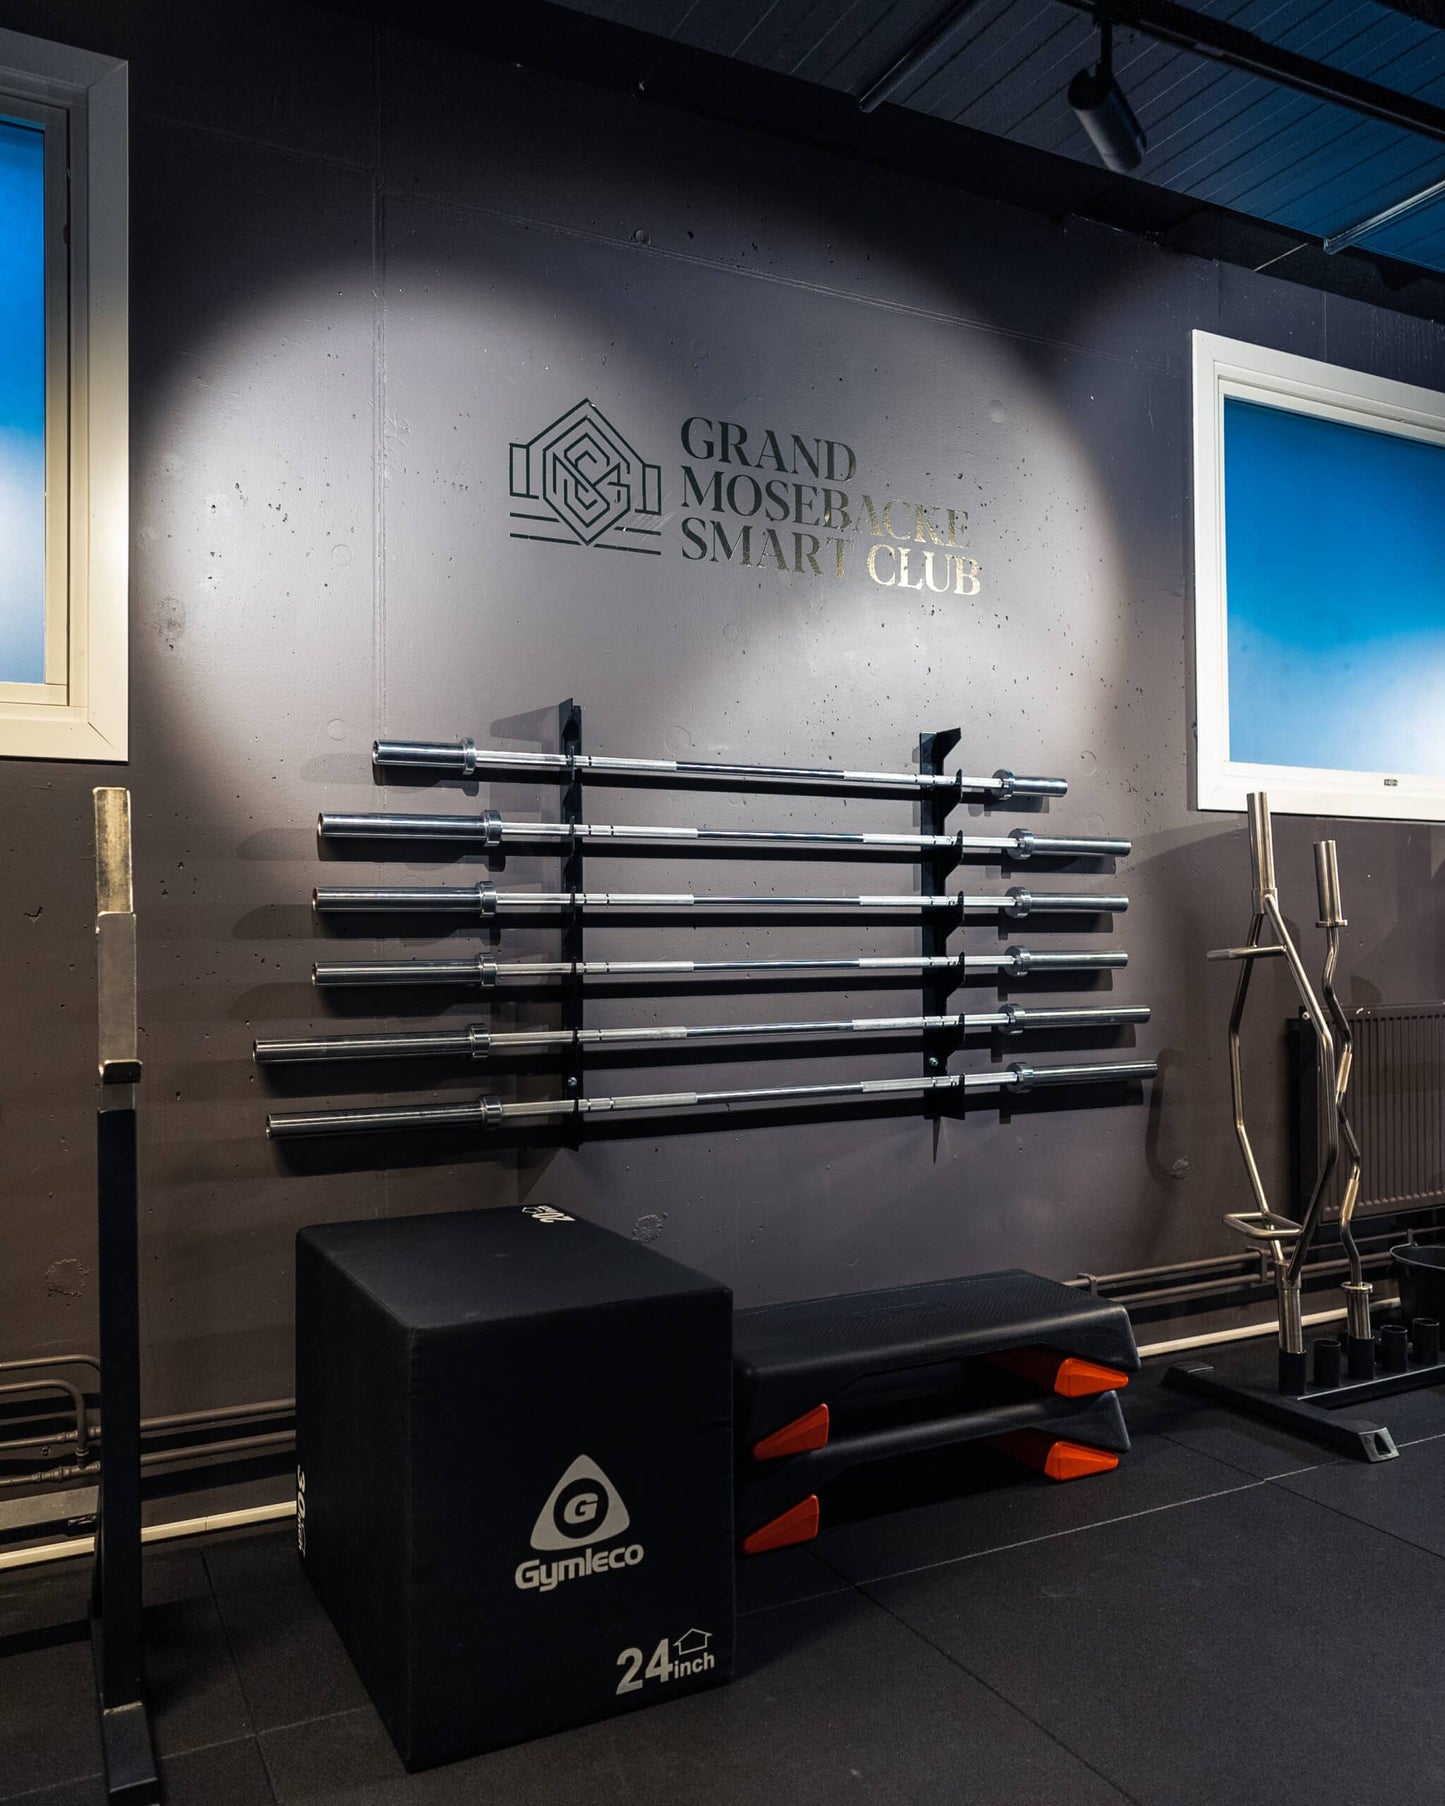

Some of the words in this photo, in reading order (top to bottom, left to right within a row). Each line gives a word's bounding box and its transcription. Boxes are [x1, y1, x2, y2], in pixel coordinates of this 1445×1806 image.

[680, 416, 856, 482] GRAND
[680, 465, 971, 548] MOSEBACKE
[681, 517, 856, 578] SMART
[867, 545, 981, 596] CLUB
[564, 1493, 599, 1524] G
[514, 1545, 645, 1592] Gymleco
